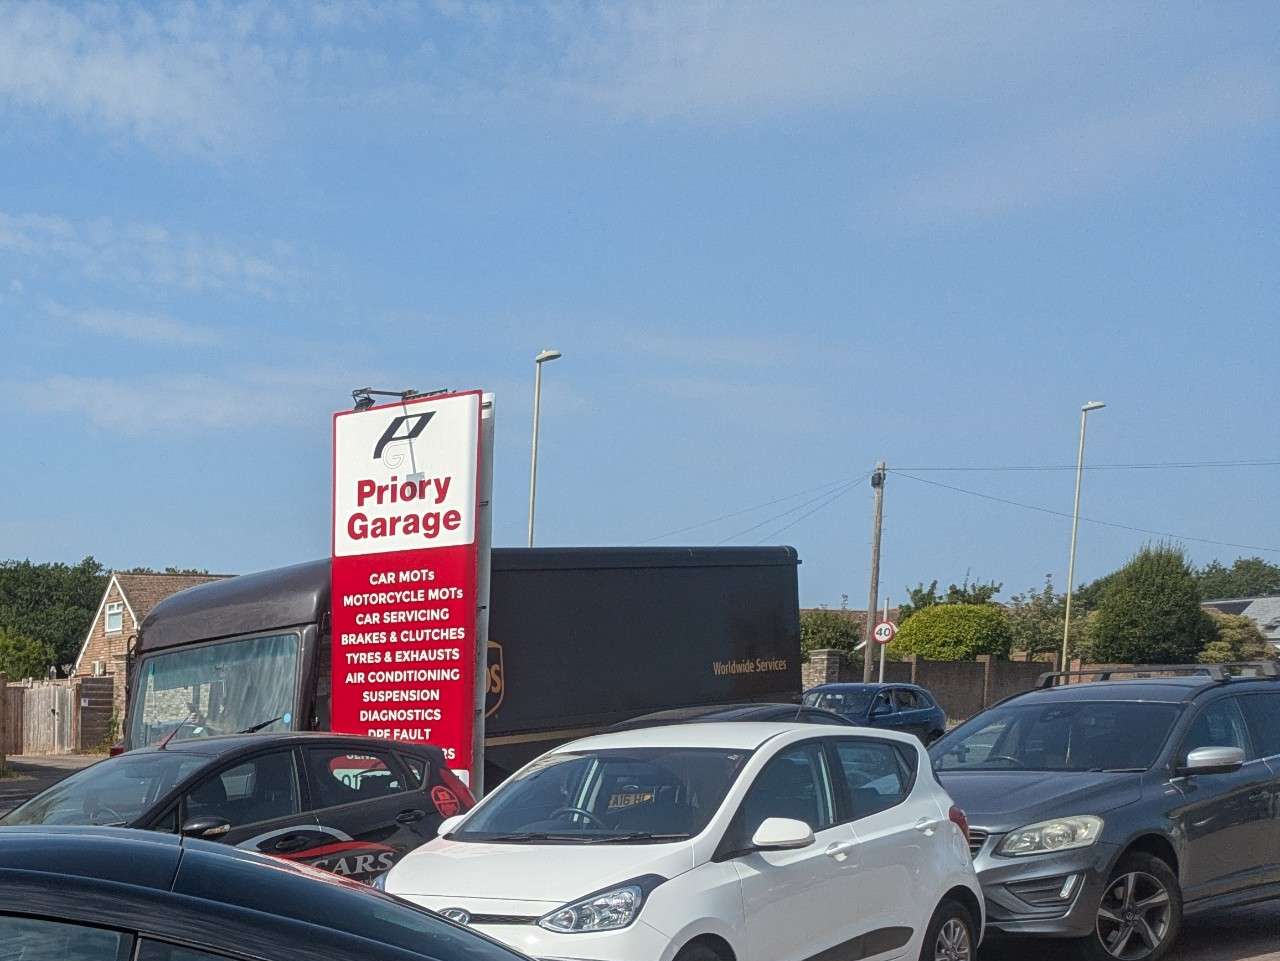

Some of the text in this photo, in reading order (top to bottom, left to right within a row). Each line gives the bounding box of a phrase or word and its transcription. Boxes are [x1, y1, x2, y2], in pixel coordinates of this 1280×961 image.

[357, 476, 451, 507] Priory
[347, 509, 462, 540] Garage
[369, 569, 435, 586] CAR MOTs
[343, 587, 464, 607] MOTORCYCLE MOTs
[355, 608, 450, 625] CAR SERVICING
[341, 628, 466, 646] BRAKES & CLUTCHES
[876, 627, 891, 637] 40
[345, 648, 460, 665] TYRES & EXHAUSTS
[713, 658, 787, 676] Worldwide Services
[345, 669, 460, 684] AIR CONDITIONING
[362, 689, 440, 703] SUSPENSION
[359, 709, 442, 722] DIAGNOSTICS
[367, 728, 432, 740] DPF FAULT
